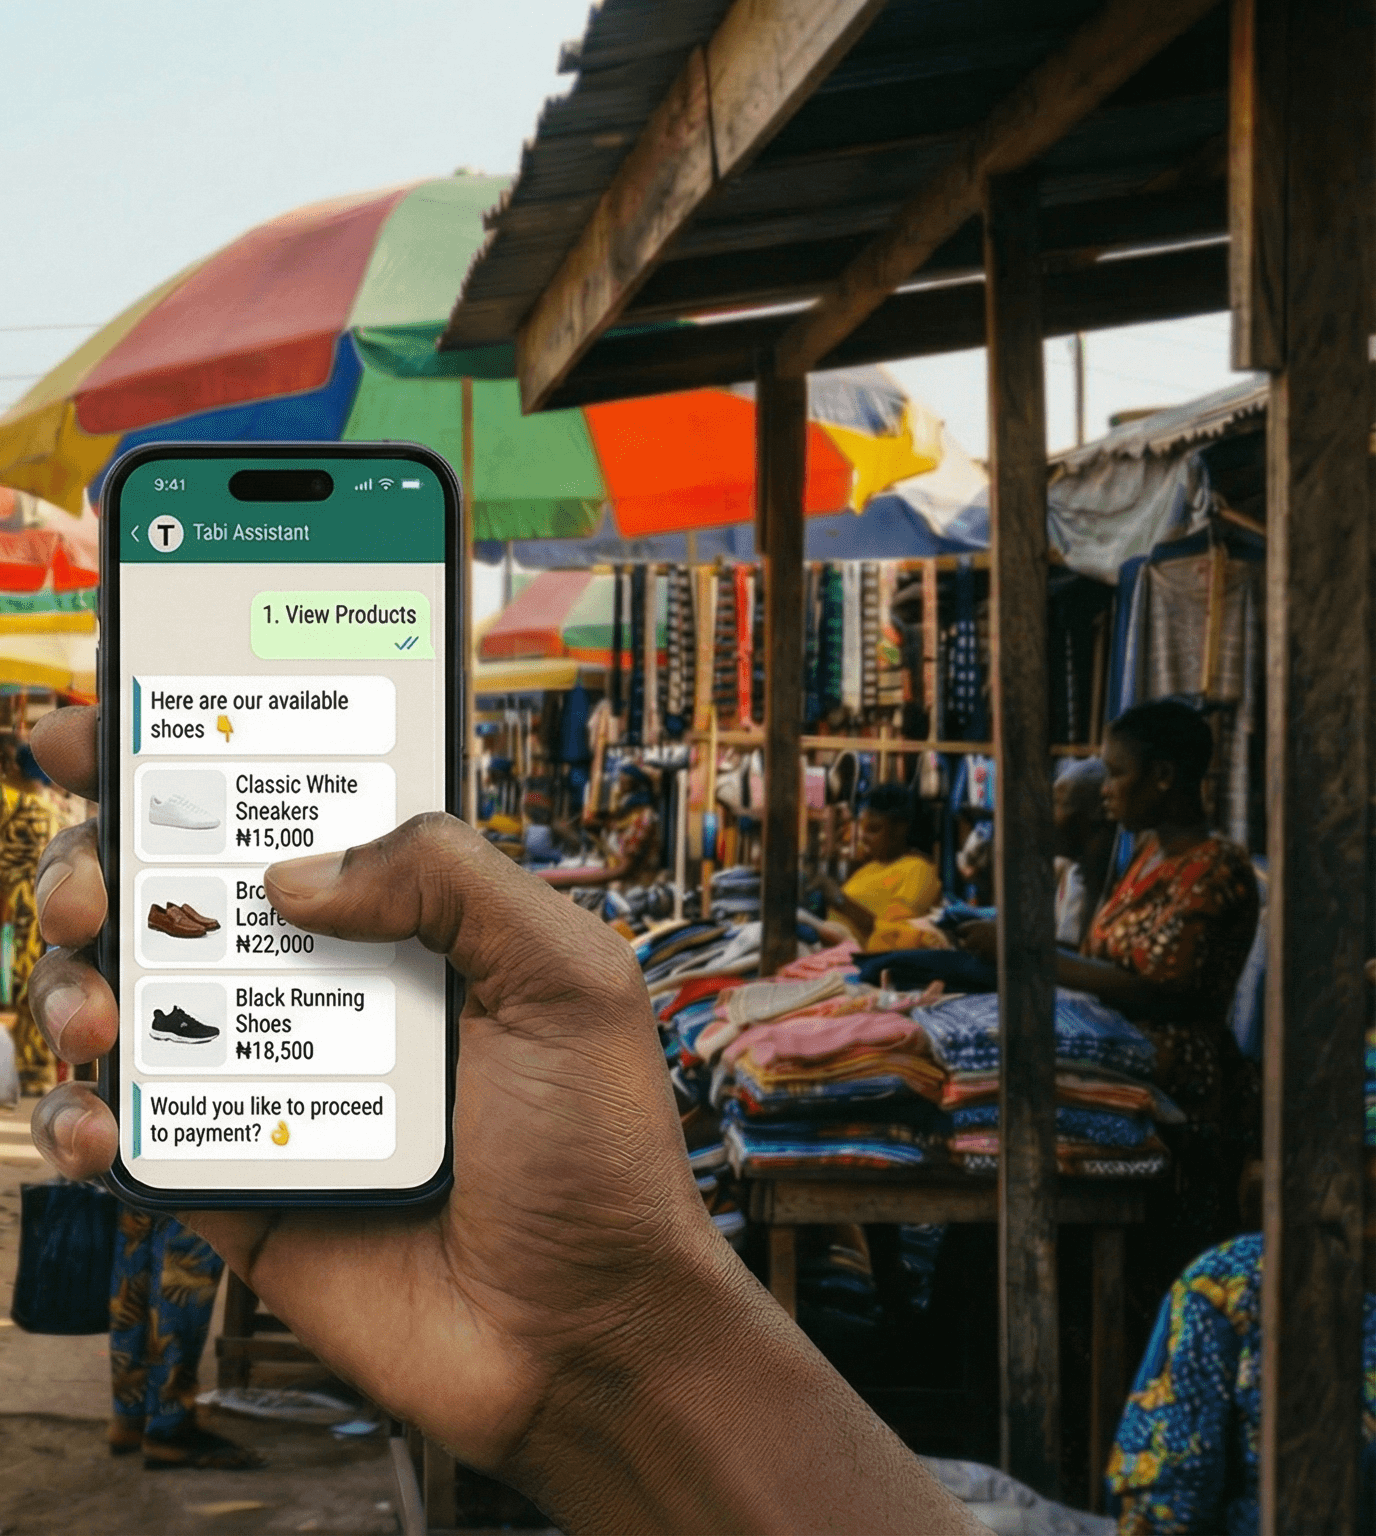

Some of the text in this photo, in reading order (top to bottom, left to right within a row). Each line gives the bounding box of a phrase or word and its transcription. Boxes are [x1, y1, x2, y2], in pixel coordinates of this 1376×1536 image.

[155, 478, 184, 491] 9:41
[157, 524, 175, 546] T
[193, 523, 309, 540] Tabi Assistant
[263, 604, 416, 624] 1. View Products
[152, 690, 348, 710] Here are our available
[151, 719, 204, 738] shoes
[236, 774, 357, 794] Classic White
[236, 801, 318, 820] Sneakers
[236, 881, 266, 900] Bro
[236, 907, 287, 926] Loafe
[236, 987, 364, 1012] Black Running
[236, 1013, 291, 1033] Shoes
[151, 1096, 383, 1120] Would you like to proceed
[150, 1123, 261, 1147] to payment?
